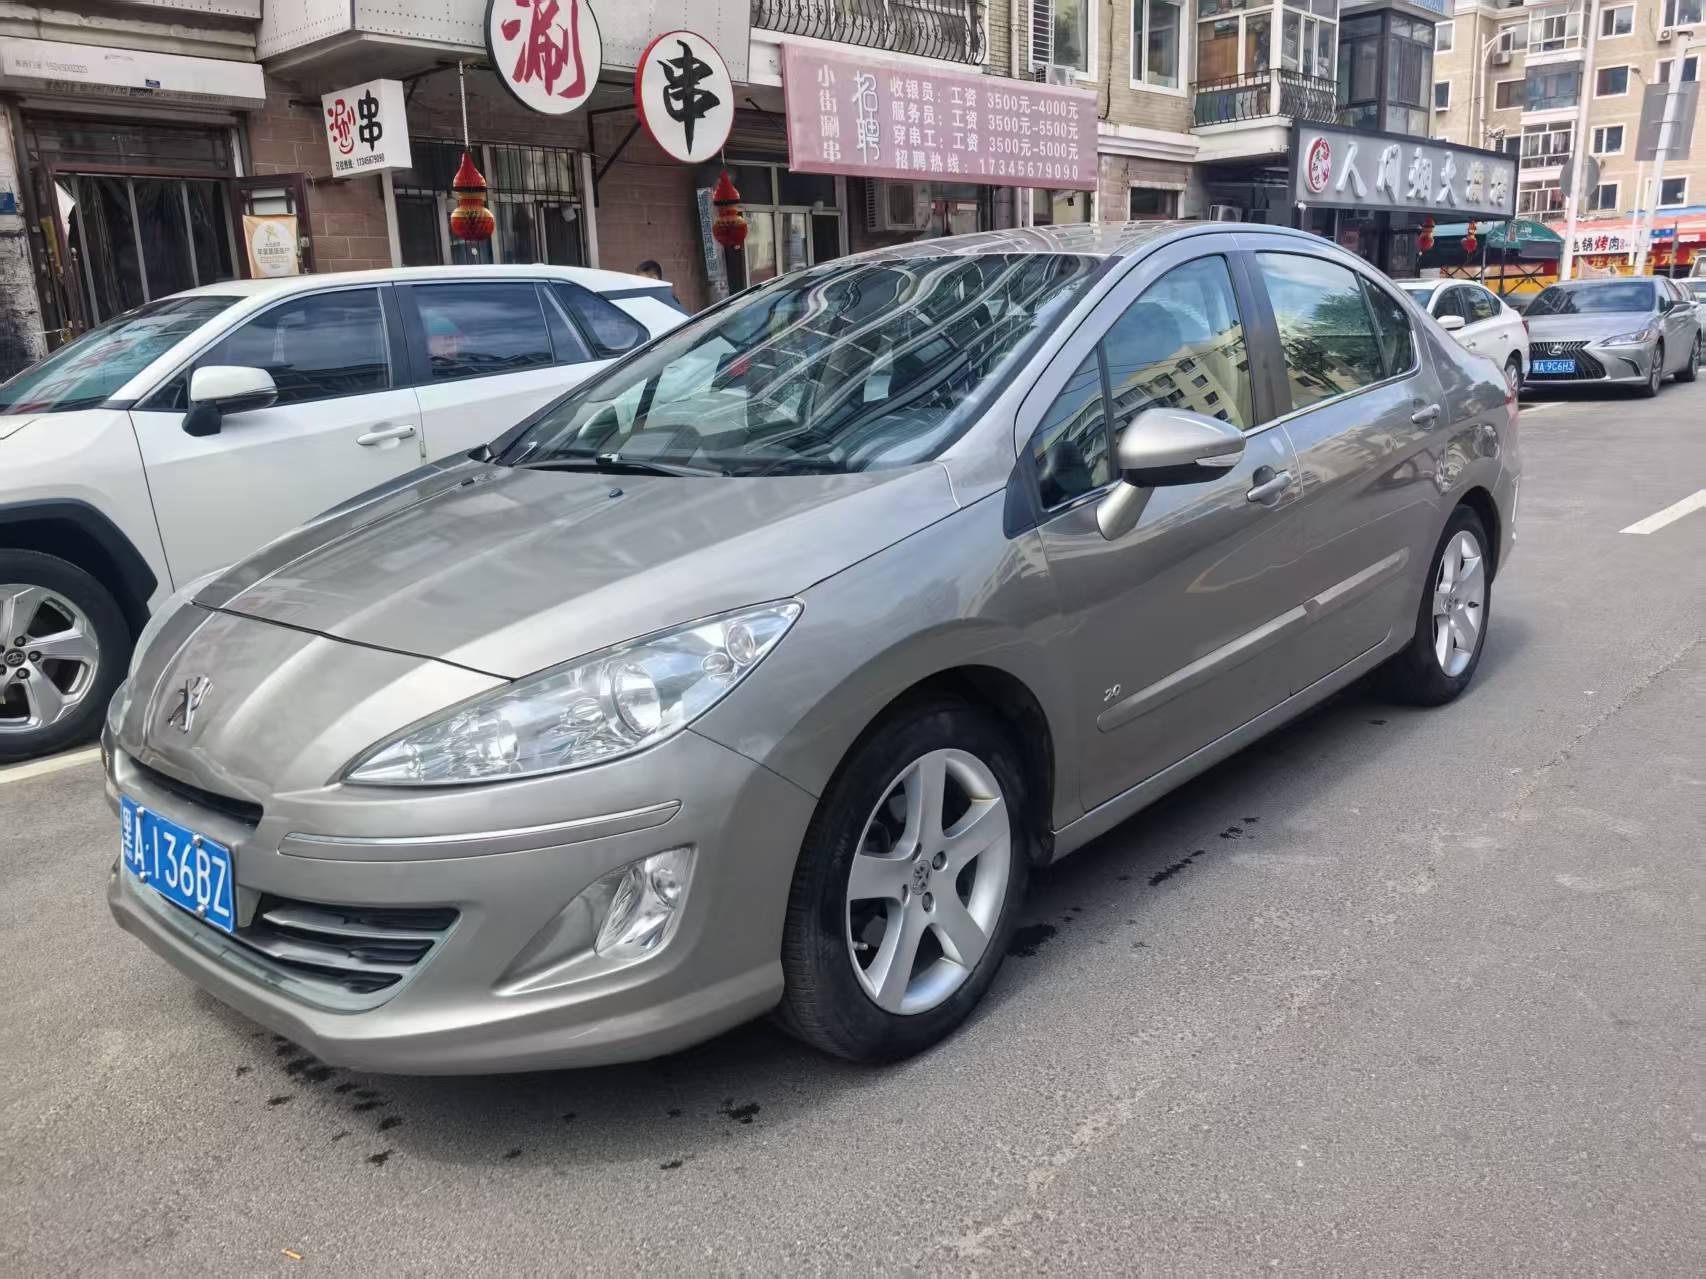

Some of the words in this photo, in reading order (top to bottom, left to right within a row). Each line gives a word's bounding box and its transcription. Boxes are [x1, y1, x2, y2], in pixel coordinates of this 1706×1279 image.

[501, 0, 586, 99] 涮
[657, 39, 721, 156] 串
[951, 87, 977, 107] 工资
[851, 70, 880, 165] 招聘
[952, 109, 977, 130] 工资
[952, 132, 978, 152] 工资
[980, 157, 1079, 180] 17345679090
